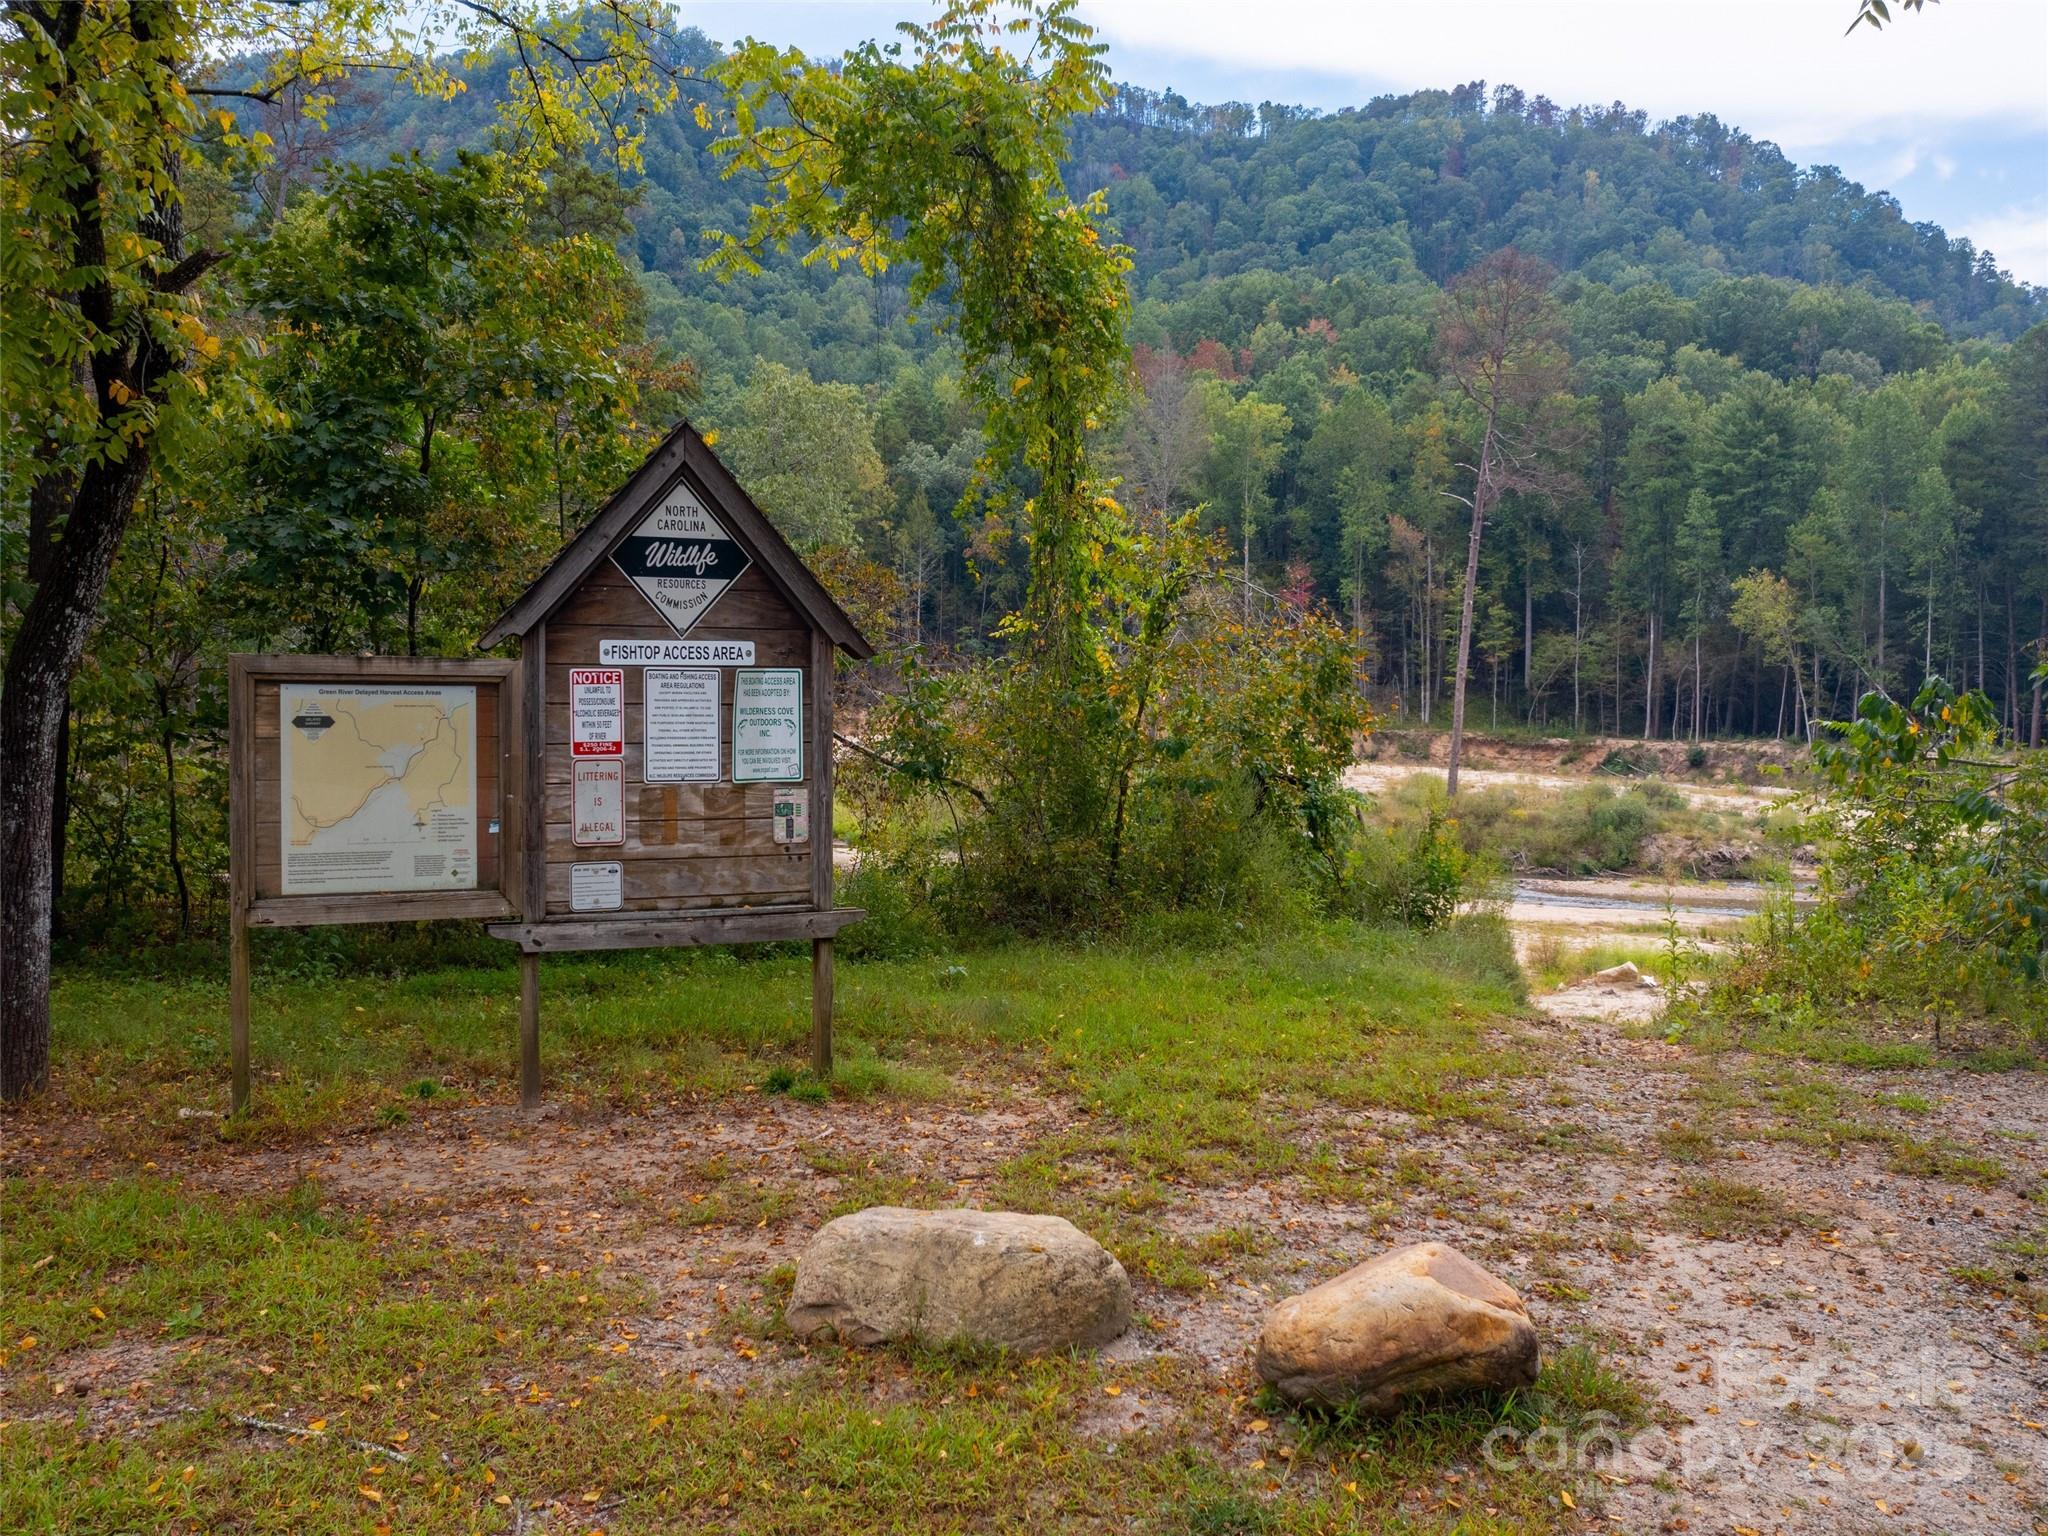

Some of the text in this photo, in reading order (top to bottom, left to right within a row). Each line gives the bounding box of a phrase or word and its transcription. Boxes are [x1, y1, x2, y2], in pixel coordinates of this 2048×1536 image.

[665, 505, 698, 517] NORTH
[657, 519, 706, 532] CAROLINA
[645, 541, 719, 575] Wildlife
[657, 578, 706, 589] RESOURCES
[655, 591, 708, 609] COMMISSION
[611, 645, 744, 660] FISHTOP ACCESS AREA
[573, 672, 620, 684] NOTICE
[649, 672, 668, 680] BOATING
[699, 673, 717, 681] ACCESS
[764, 677, 782, 685] ACCESS
[783, 677, 795, 685] AREA
[355, 688, 379, 696] Delayed
[584, 686, 612, 694] UNLAWFUL TO
[575, 709, 597, 717] ALCOHOLIC
[740, 707, 794, 715] WILDERNESS COVE
[602, 720, 612, 728] FEET
[759, 729, 772, 737] INC.
[578, 771, 618, 782] LITTERING
[594, 797, 602, 807] IS
[580, 822, 615, 832] ILLEGAL
